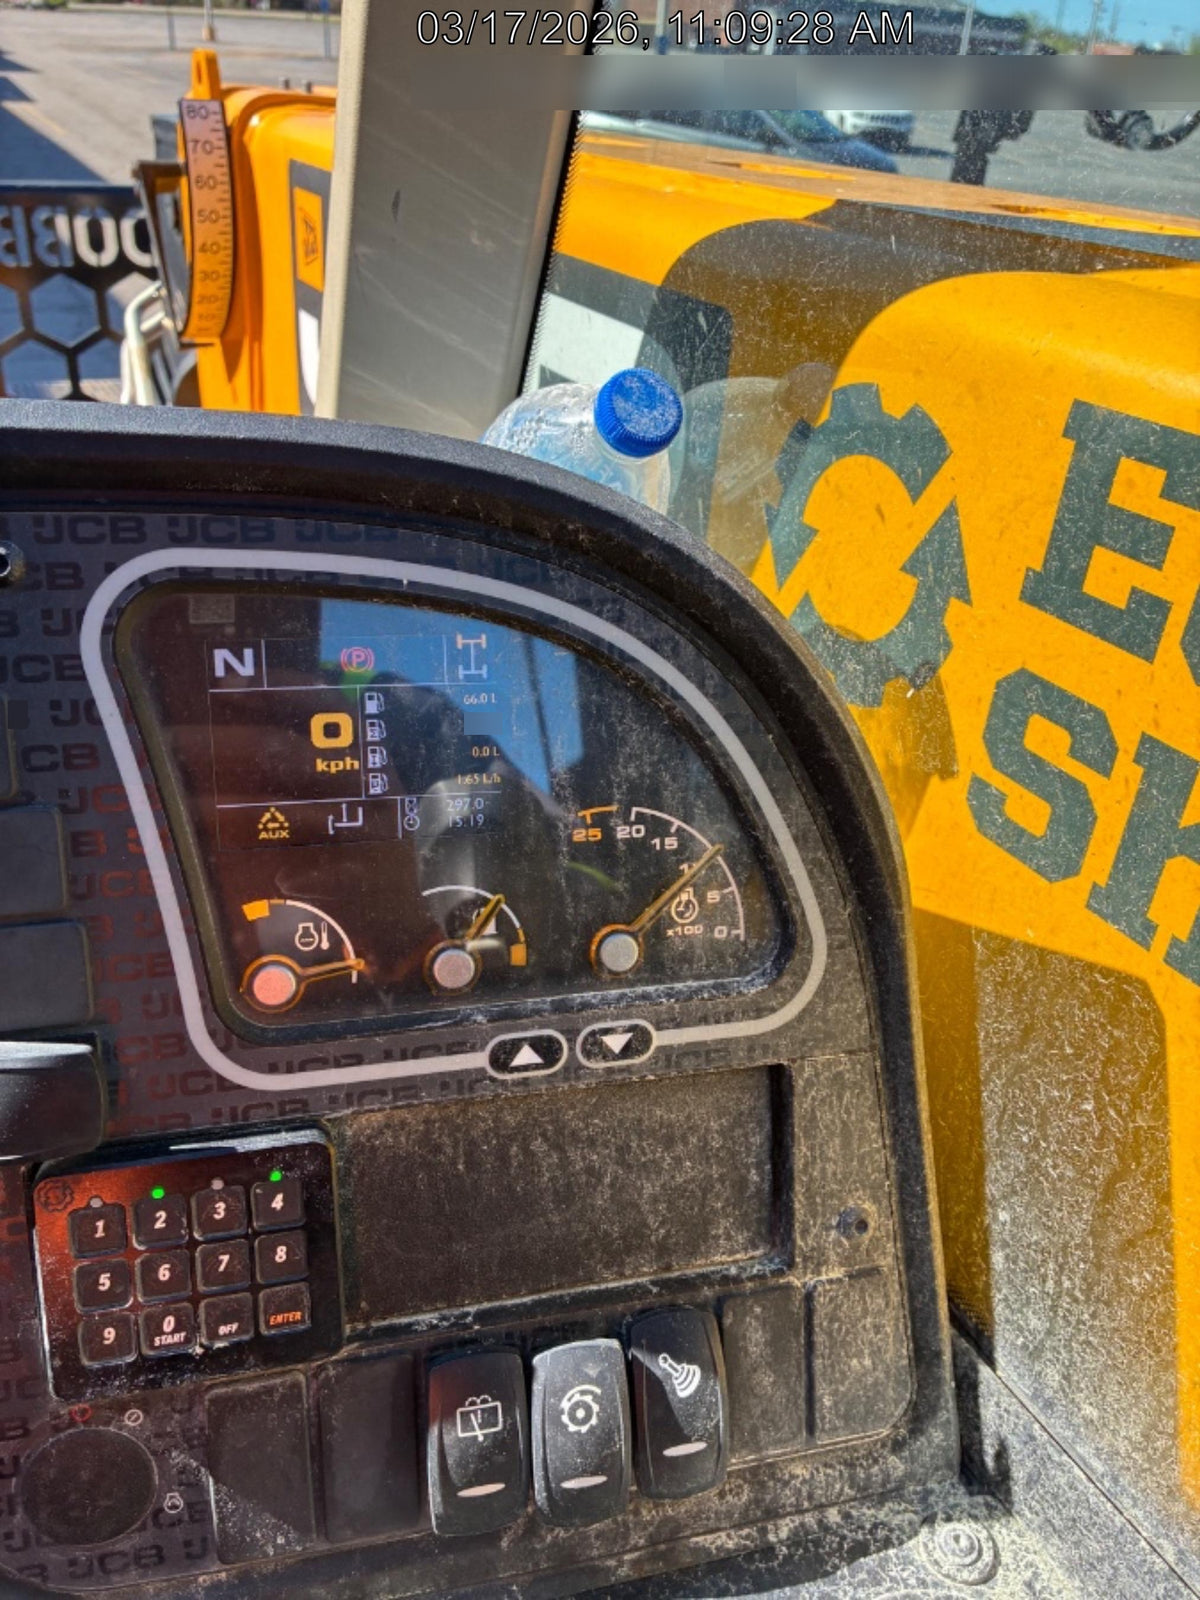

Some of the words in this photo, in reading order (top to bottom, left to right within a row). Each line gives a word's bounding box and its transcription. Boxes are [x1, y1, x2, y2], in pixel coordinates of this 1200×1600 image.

[186, 105, 210, 119] 80
[190, 140, 214, 154] 70
[195, 175, 217, 190] 60
[197, 209, 221, 224] 50
[199, 241, 221, 255] 40
[200, 269, 221, 282] 30
[33, 515, 147, 544] JCB
[167, 516, 276, 543] JCB
[1019, 398, 1200, 686] E
[213, 648, 255, 678] N
[310, 713, 354, 749] 0
[472, 746, 490, 758] 0.0
[315, 757, 360, 774] kph
[446, 797, 485, 812] 297.0
[258, 829, 290, 840] AUX
[572, 828, 603, 842] 25
[616, 824, 646, 839] 20
[651, 837, 679, 851] 15
[707, 889, 721, 904] 5
[666, 925, 703, 937] x100
[714, 926, 728, 939] 0
[270, 1192, 285, 1211] 4
[213, 1201, 226, 1220] 3
[155, 1210, 167, 1230] 2
[94, 1220, 106, 1239] 1
[274, 1245, 287, 1264] 8
[218, 1254, 230, 1273] 7
[158, 1263, 171, 1282] 6
[98, 1273, 111, 1292] 5
[163, 1315, 174, 1333] 0
[268, 1311, 303, 1326] ENTER
[103, 1326, 116, 1345] 9
[217, 1321, 239, 1336] OFF
[153, 1331, 187, 1347] START
